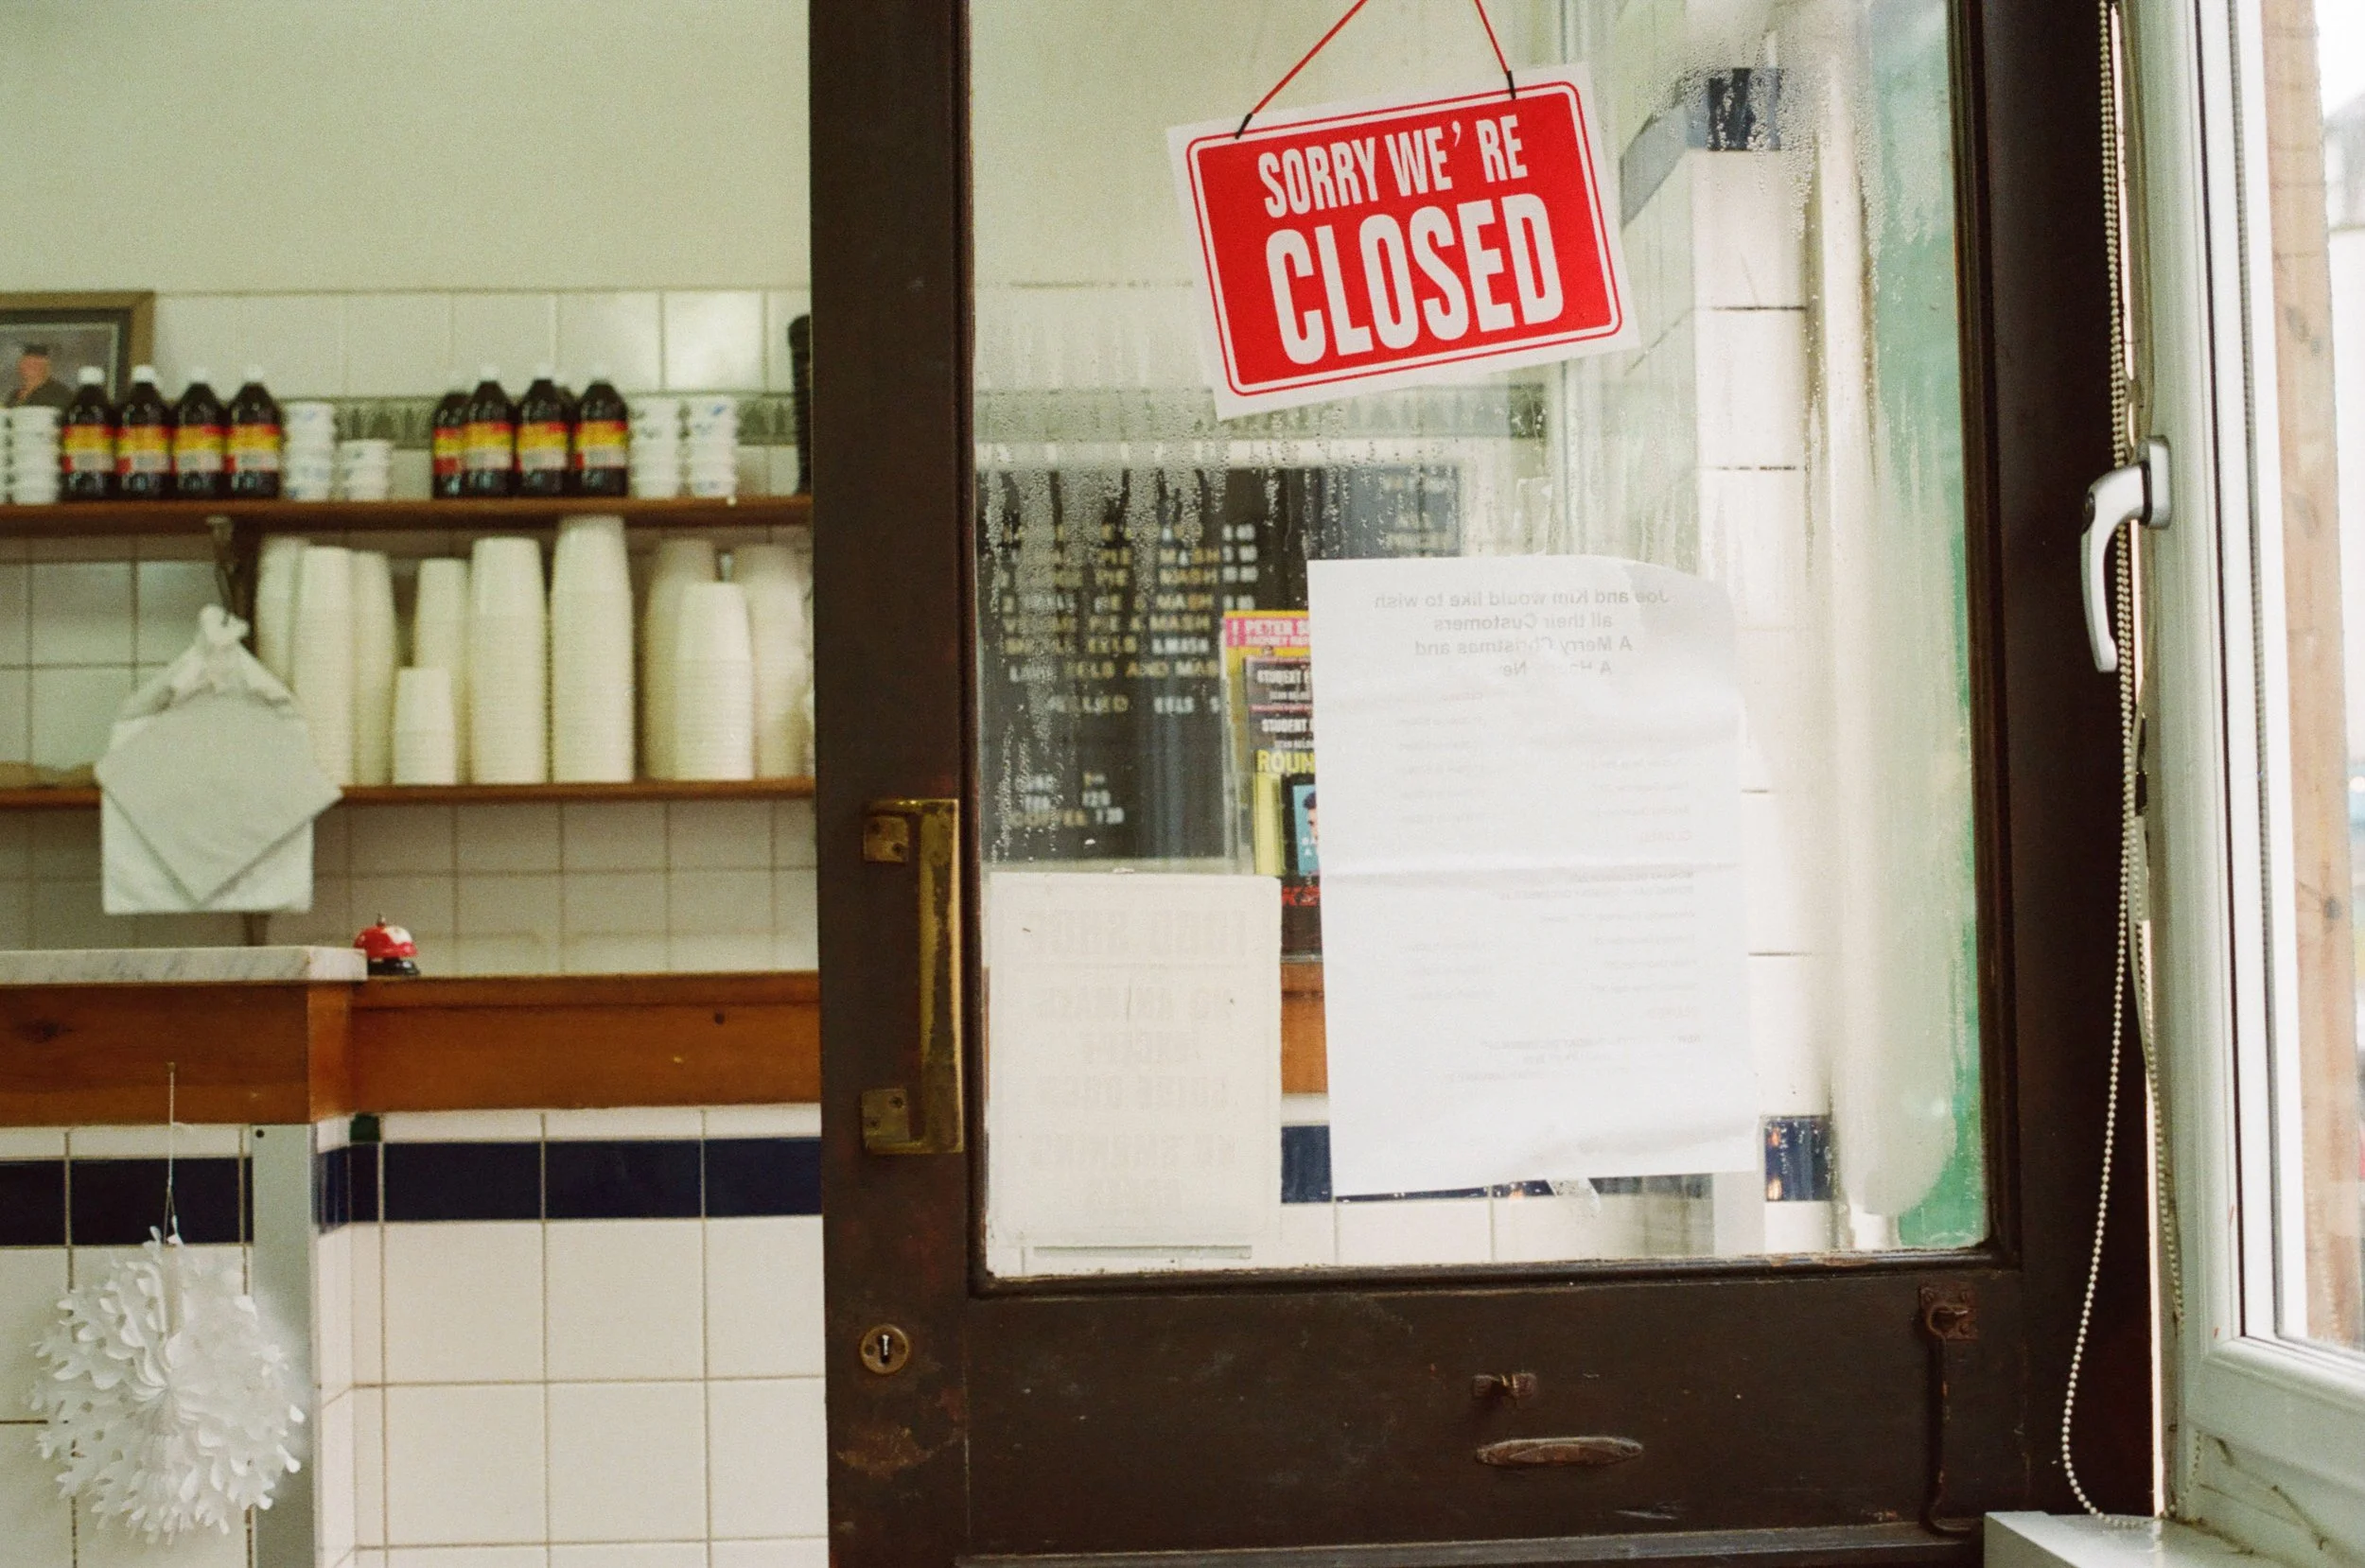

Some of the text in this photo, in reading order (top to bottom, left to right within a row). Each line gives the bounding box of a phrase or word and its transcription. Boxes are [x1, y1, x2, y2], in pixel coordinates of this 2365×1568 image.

[1257, 136, 1379, 218] SORRY
[1265, 193, 1564, 365] CLOSED
[1257, 749, 1316, 775] ROUN
